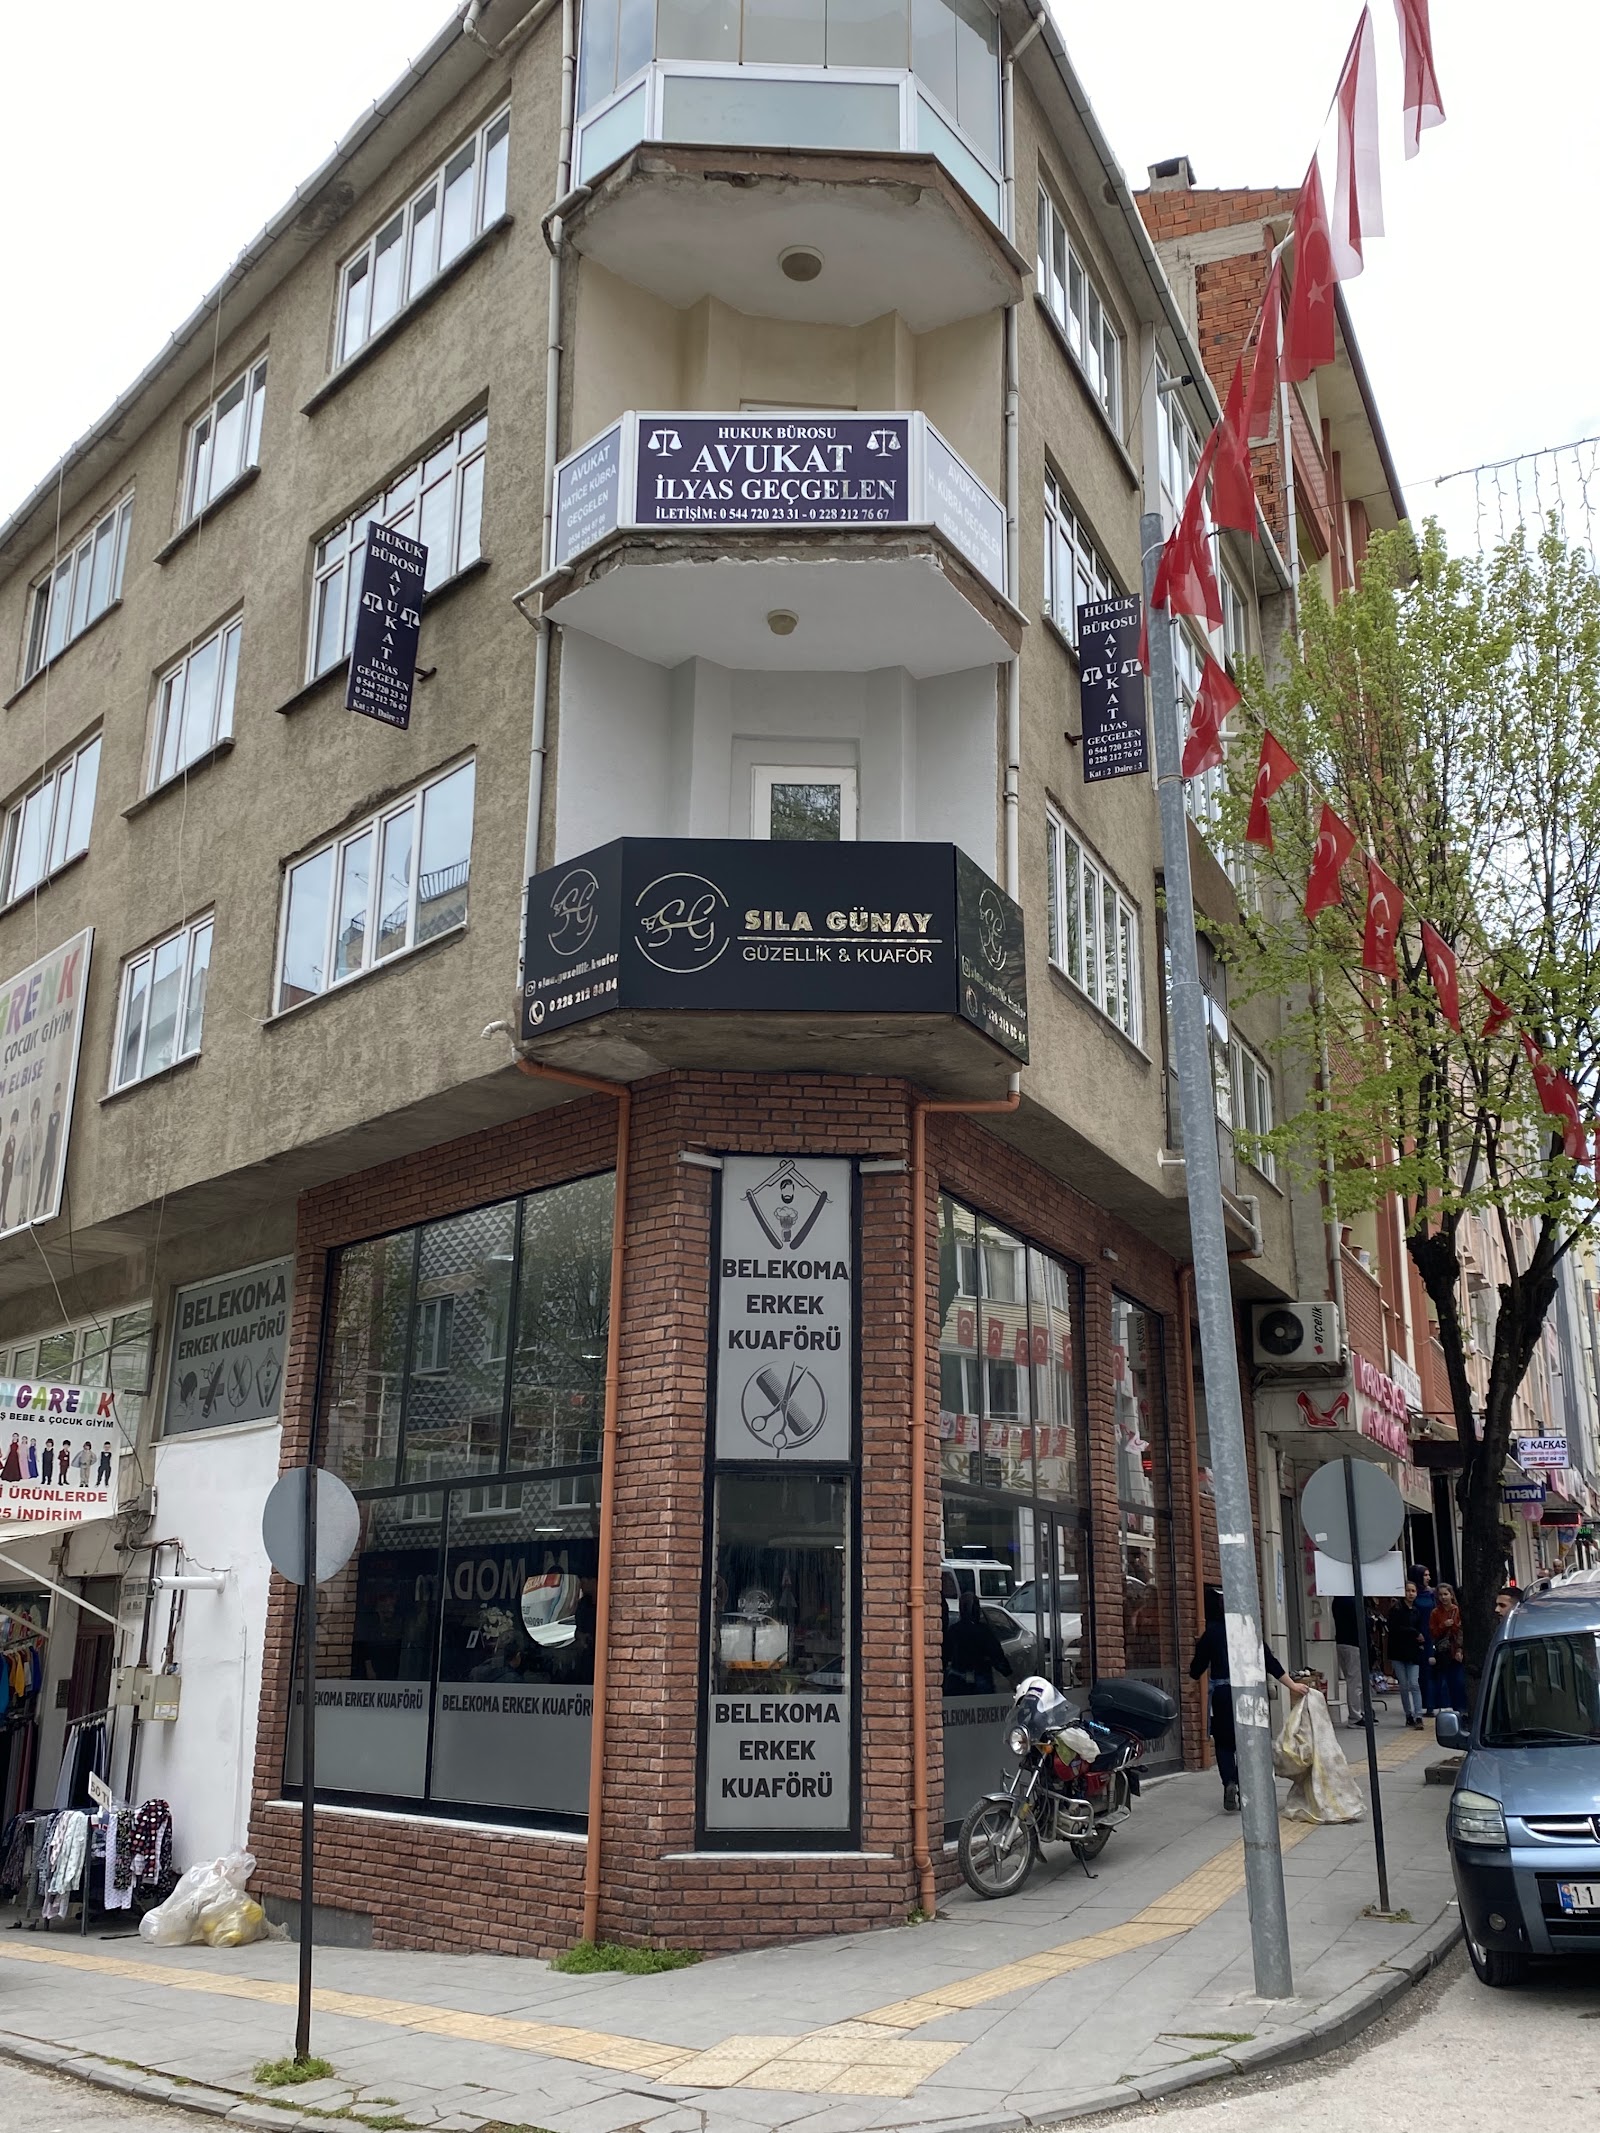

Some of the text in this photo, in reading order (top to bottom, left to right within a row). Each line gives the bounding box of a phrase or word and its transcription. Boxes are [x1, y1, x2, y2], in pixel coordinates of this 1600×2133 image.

[718, 426, 837, 439] HUKUK BÜROSU
[571, 445, 610, 485] AVUKAT
[690, 444, 852, 473] AVUKAT
[561, 464, 616, 512] HATİCE KÜBRA
[654, 474, 896, 505] İLYAS GEÇGELEN
[948, 464, 982, 511] AVUKAT
[567, 490, 608, 527] GEÇGELEN
[656, 507, 717, 521] İLETİŞİM:
[720, 509, 726, 520] 0
[729, 509, 748, 520] 544
[751, 509, 769, 520] 720
[772, 509, 784, 520] 23
[787, 509, 799, 520] 31
[809, 509, 816, 520] 0
[819, 509, 838, 520] 228
[840, 509, 858, 520] 212
[862, 509, 874, 520] 76
[877, 509, 889, 520] 67
[375, 528, 424, 560] HUKUK
[371, 545, 425, 578] BÜROSU
[381, 570, 402, 660] AVUKAT
[1084, 598, 1135, 619] HUKUK
[1082, 614, 1137, 636] BÜROSU
[371, 657, 399, 677] İLYAS
[1104, 633, 1120, 720] AVUKAT
[357, 665, 409, 692] GEÇGELEN
[1087, 729, 1141, 746] GEÇGELEN
[1100, 721, 1128, 733] İLYAS
[1123, 741, 1132, 750] 23
[1133, 739, 1142, 748] 31
[1109, 752, 1122, 762] 212
[1089, 768, 1102, 779] Kat
[1114, 764, 1133, 774] Daire
[744, 906, 933, 933] SILA GÜNAY
[742, 945, 933, 964] GÜZELLİK & KUAFÖR
[549, 1000, 556, 1012] 0
[557, 995, 573, 1009] 228
[575, 988, 590, 1004] 212
[4, 1008, 74, 1070] ÇOCUK GİYİM
[723, 1259, 850, 1280] BELEKOMA
[182, 1275, 286, 1330] BELEKOMA
[747, 1294, 824, 1315] ERKEK
[1312, 1306, 1325, 1343] arçelik
[178, 1310, 286, 1361] ERKEK KUAFÖRÜ
[728, 1325, 841, 1351] KUAFÖRÜ
[9, 1412, 35, 1422] BEBE
[38, 1415, 46, 1423] &
[49, 1416, 83, 1426] ÇOCUK
[86, 1416, 114, 1428] GİYİM
[1530, 1440, 1567, 1449] KAFKAS
[9, 1485, 108, 1502] ÜRÜNLERDE
[1506, 1488, 1542, 1499] mavi
[17, 1506, 82, 1521] İNDİRİM
[296, 1688, 423, 1709] BEKOMA ERKEK KUAFÖRÜ
[442, 1694, 500, 1713] BELEKOMA
[502, 1696, 539, 1714] ERKEK
[715, 1703, 840, 1723] BELEKOMA
[977, 1706, 1000, 1724] ERKEK
[739, 1740, 816, 1761] ERKEK
[722, 1771, 832, 1798] KUAFÖRÜ
